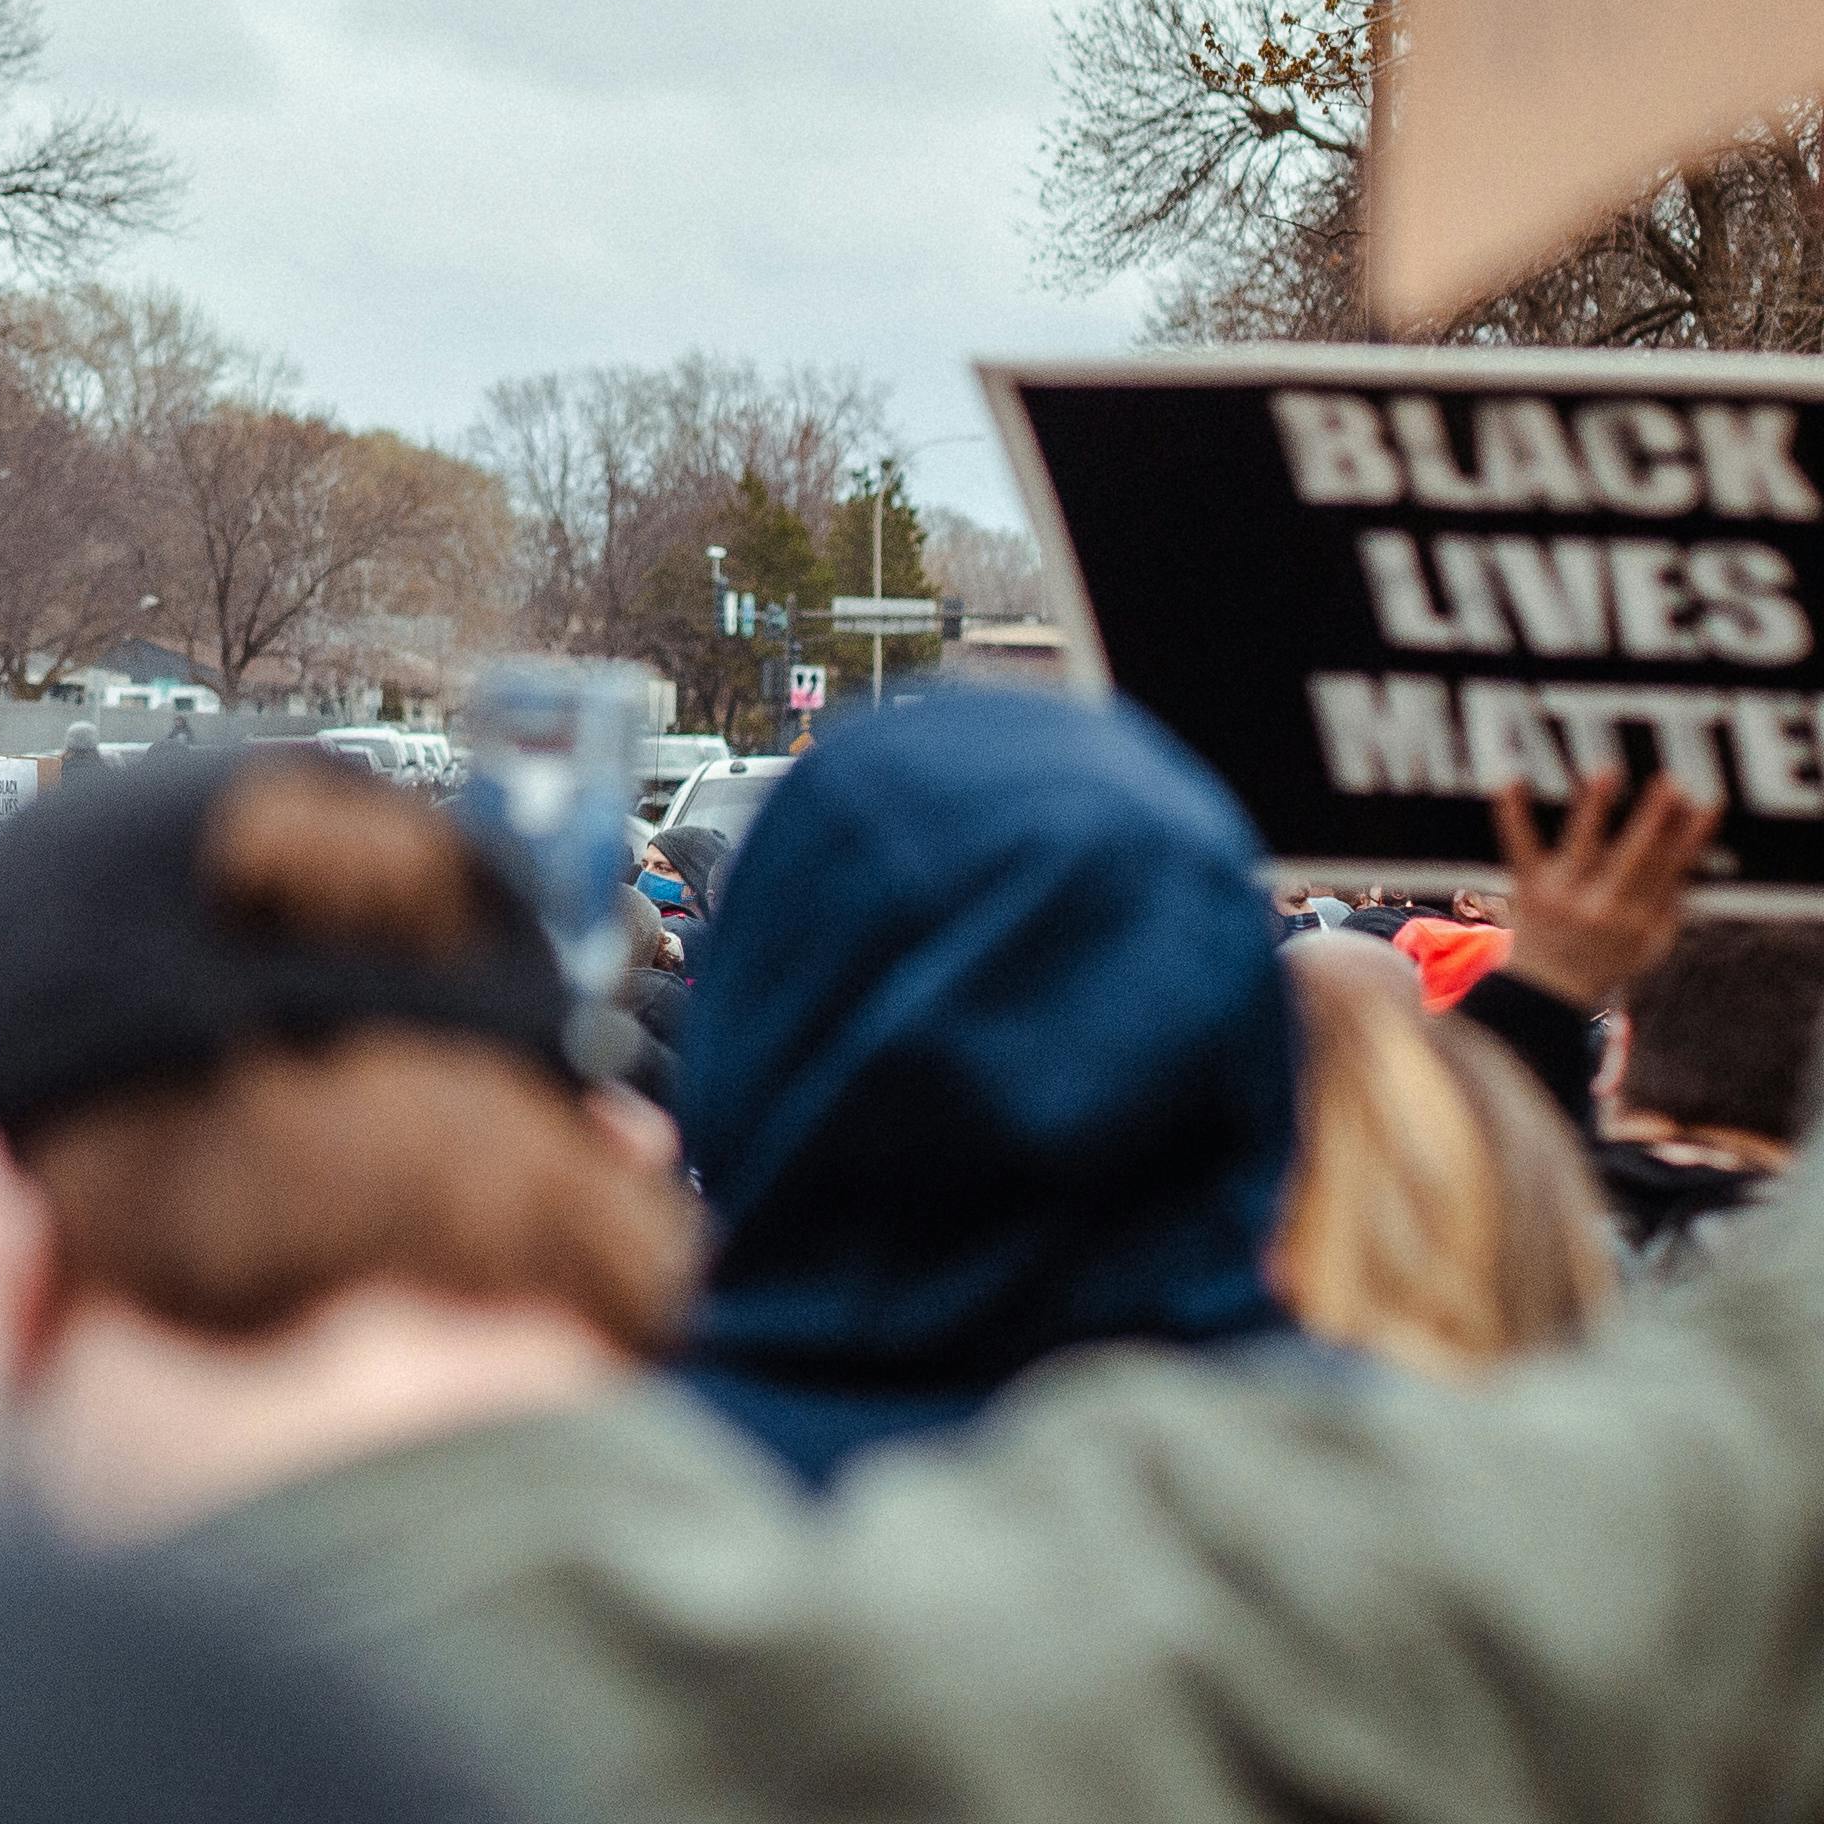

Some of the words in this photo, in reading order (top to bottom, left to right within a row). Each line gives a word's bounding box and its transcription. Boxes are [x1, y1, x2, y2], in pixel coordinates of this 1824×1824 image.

[1269, 388, 1823, 523] BLACK
[1359, 528, 1813, 666] LIVES
[1306, 671, 1824, 819] MATTE
